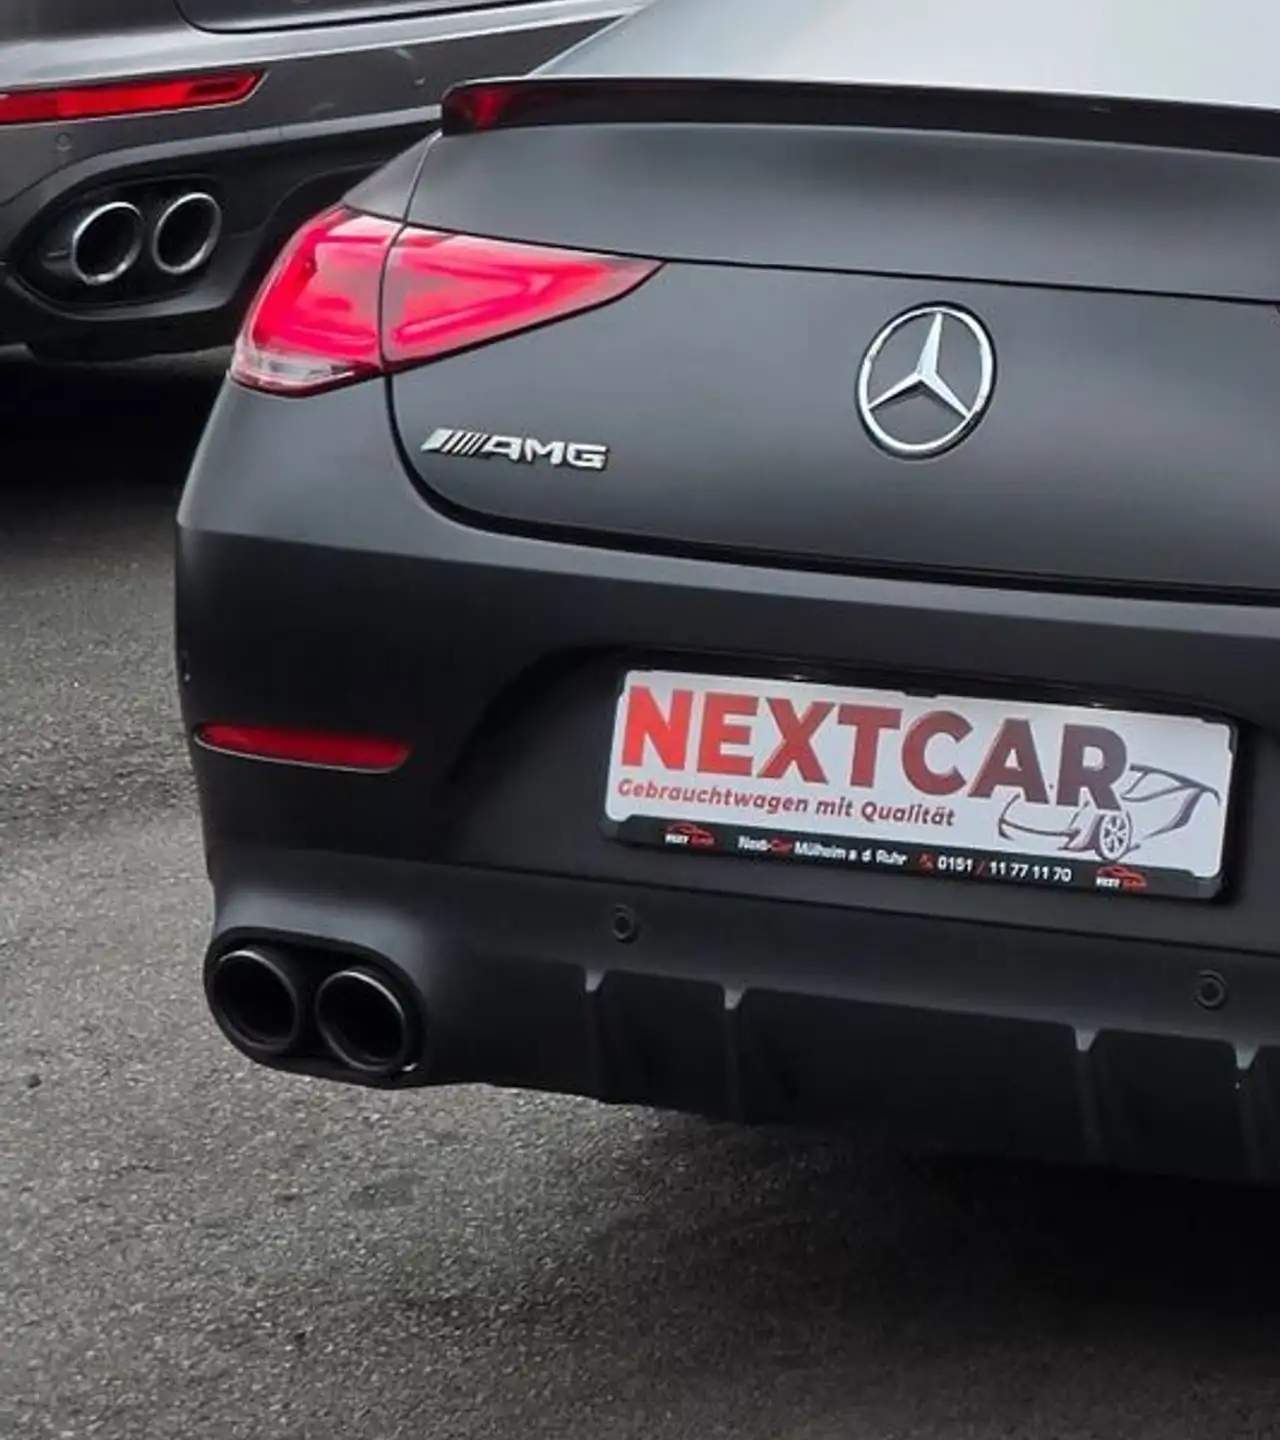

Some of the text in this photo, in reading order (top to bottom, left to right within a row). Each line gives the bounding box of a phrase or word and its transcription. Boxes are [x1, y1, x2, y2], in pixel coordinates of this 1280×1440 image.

[481, 433, 609, 471] AMG
[621, 685, 1128, 812] NEXTCAR
[616, 777, 956, 827] Gebrauchtwagen mit Qualität
[937, 857, 973, 872] 0151
[989, 861, 1006, 876] 11
[1010, 863, 1027, 878] 77
[1032, 864, 1049, 879] 11
[1052, 866, 1072, 883] 70
